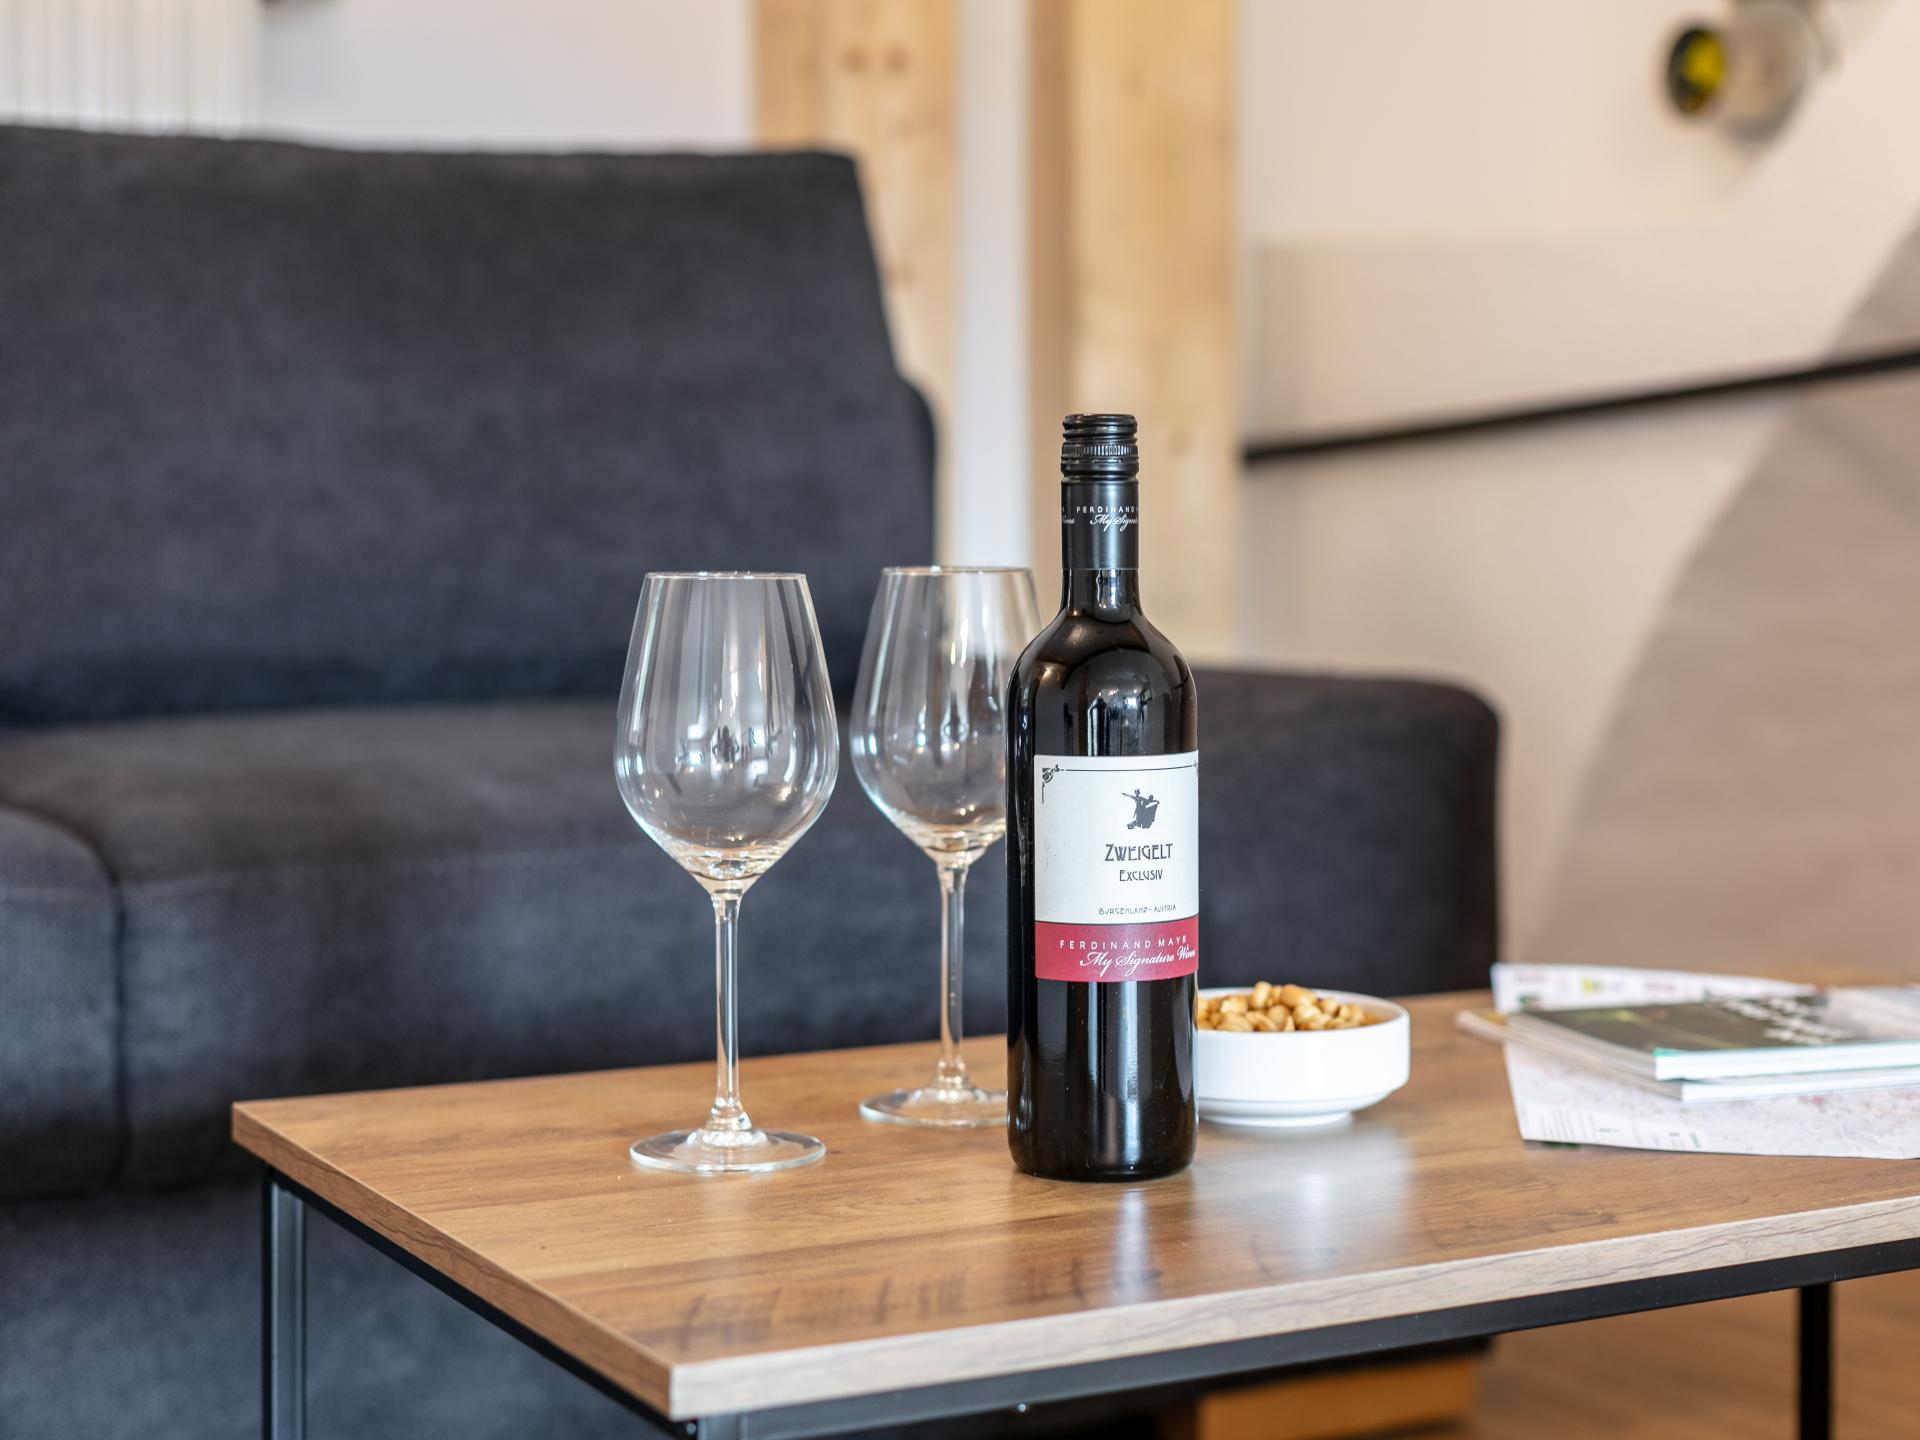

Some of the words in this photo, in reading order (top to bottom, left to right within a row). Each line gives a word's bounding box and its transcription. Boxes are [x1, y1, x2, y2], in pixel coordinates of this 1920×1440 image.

[1076, 505, 1135, 514] FERDINAND
[1089, 513, 1111, 532] My
[1104, 842, 1173, 862] ZWEIGELT
[1119, 869, 1164, 882] EXCLUSIV
[1059, 939, 1151, 950] FERDINAND
[1158, 935, 1187, 948] MAYR
[1079, 951, 1113, 978] My
[1115, 950, 1175, 977] Signature
